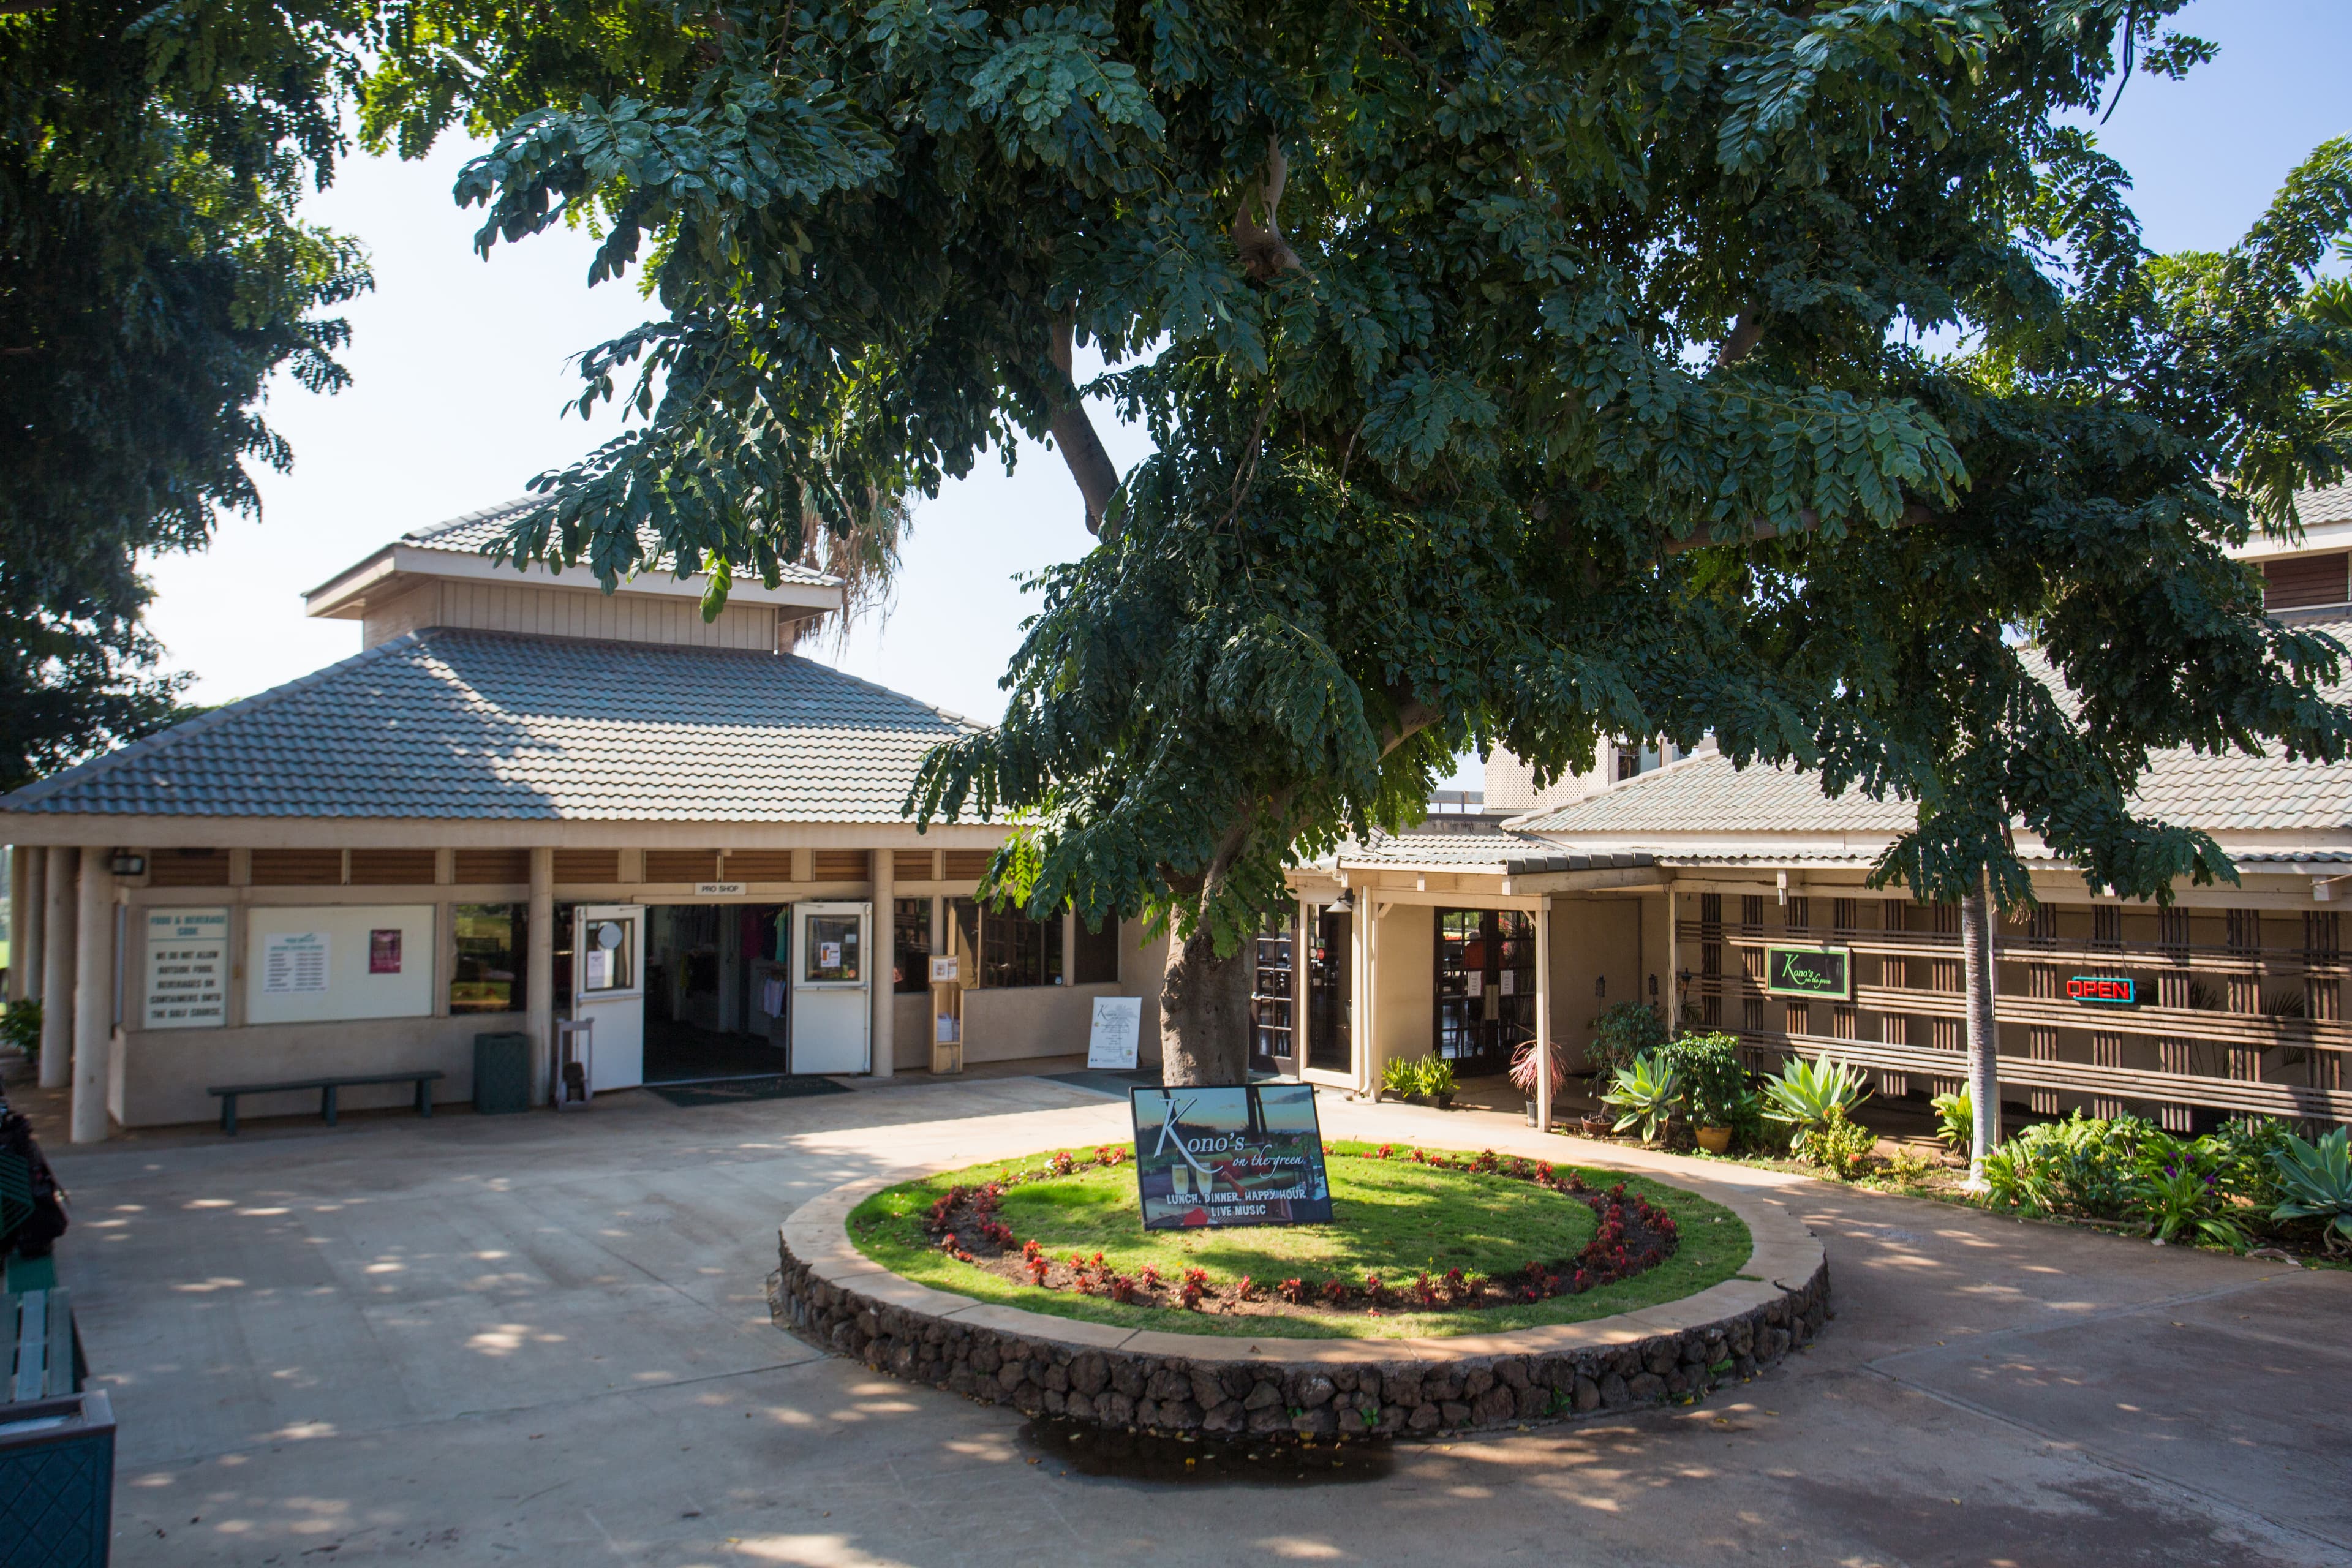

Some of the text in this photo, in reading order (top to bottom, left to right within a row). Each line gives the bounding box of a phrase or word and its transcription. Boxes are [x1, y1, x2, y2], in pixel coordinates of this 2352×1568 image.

[150, 916, 171, 925] FOOD
[157, 966, 190, 974] OUTSIDE
[1782, 954, 1814, 985] Kono's
[157, 981, 201, 989] BEVERAGES
[1814, 979, 1831, 989] green
[2067, 981, 2130, 1000] OPEN
[149, 995, 198, 1004] CONTAINERS
[151, 1009, 166, 1019] THE
[1153, 1097, 1245, 1174] Kono's
[1232, 1144, 1305, 1180] on the green
[1245, 1188, 1275, 1201] HAPPY
[1280, 1188, 1306, 1200] HOUR
[1211, 1204, 1266, 1217] LIVE MUSIC
